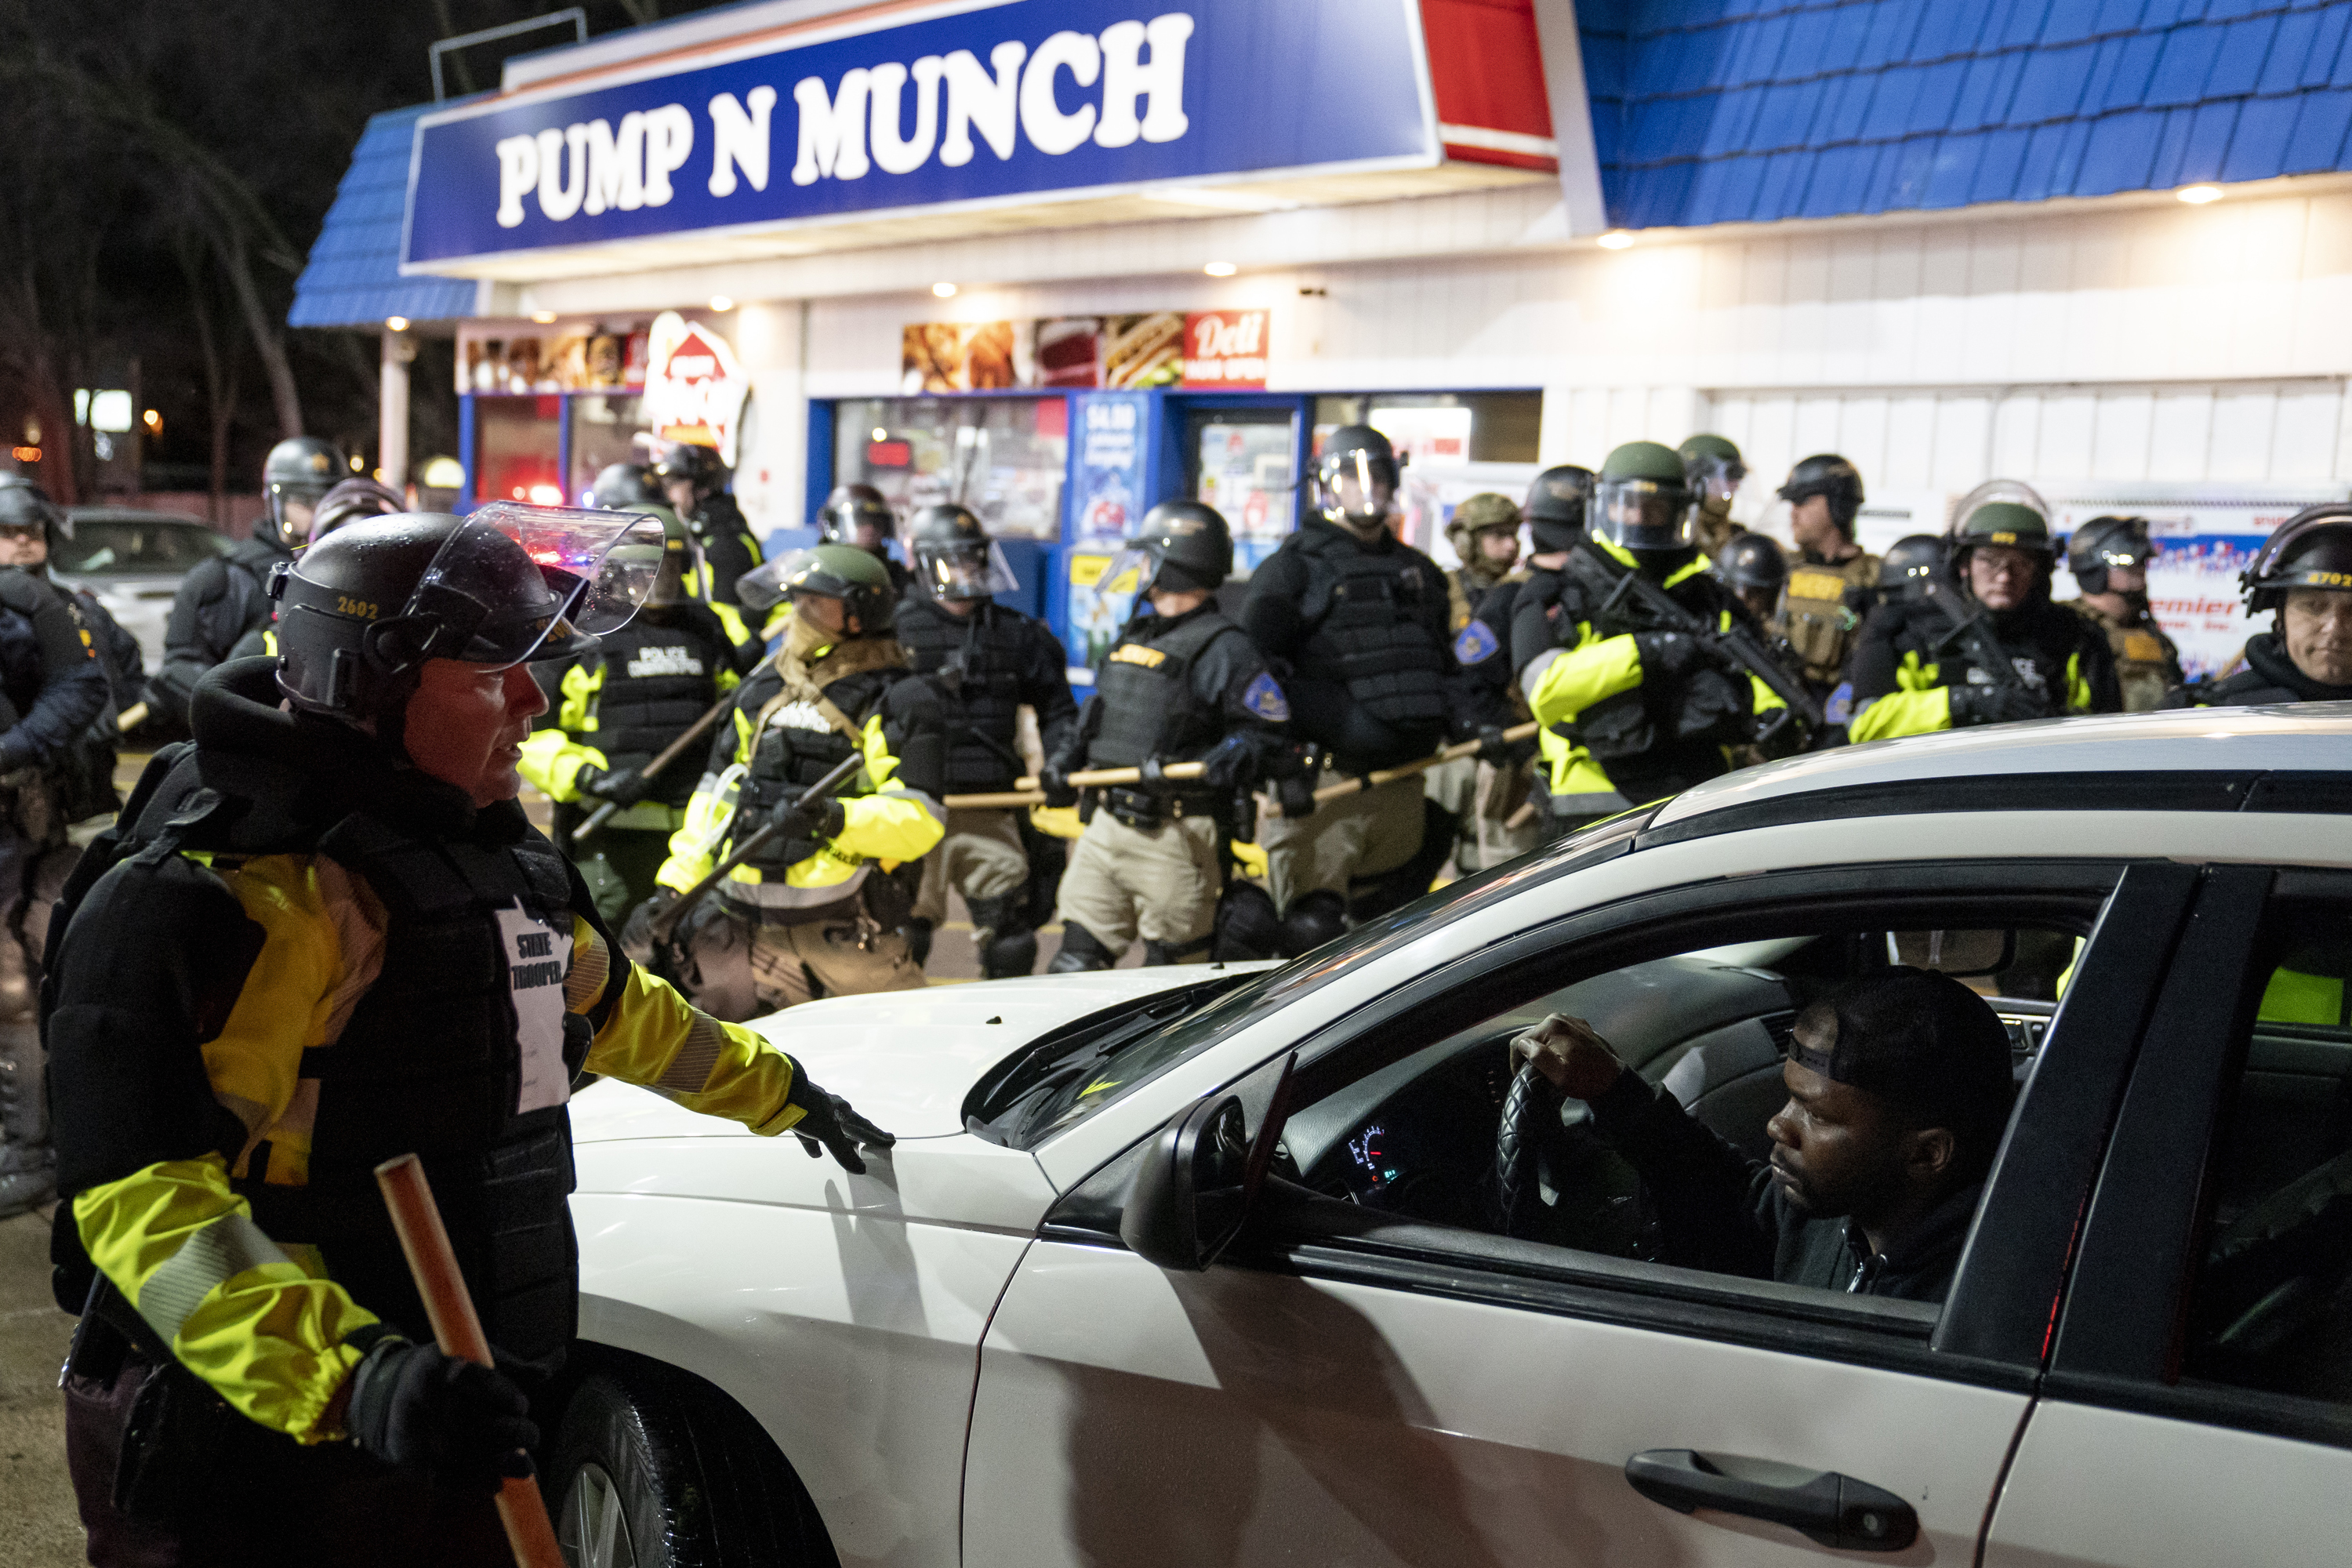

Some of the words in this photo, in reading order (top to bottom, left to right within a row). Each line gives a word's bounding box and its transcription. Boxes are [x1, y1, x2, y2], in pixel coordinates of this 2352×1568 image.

[496, 103, 694, 228] PUMP
[708, 85, 777, 198] N
[791, 13, 1195, 187] MUNCH
[1194, 314, 1263, 358] Deli
[337, 596, 379, 620] 2602
[638, 646, 688, 662] POLICE
[517, 932, 552, 959] STATE
[510, 960, 562, 990] TROOPER
